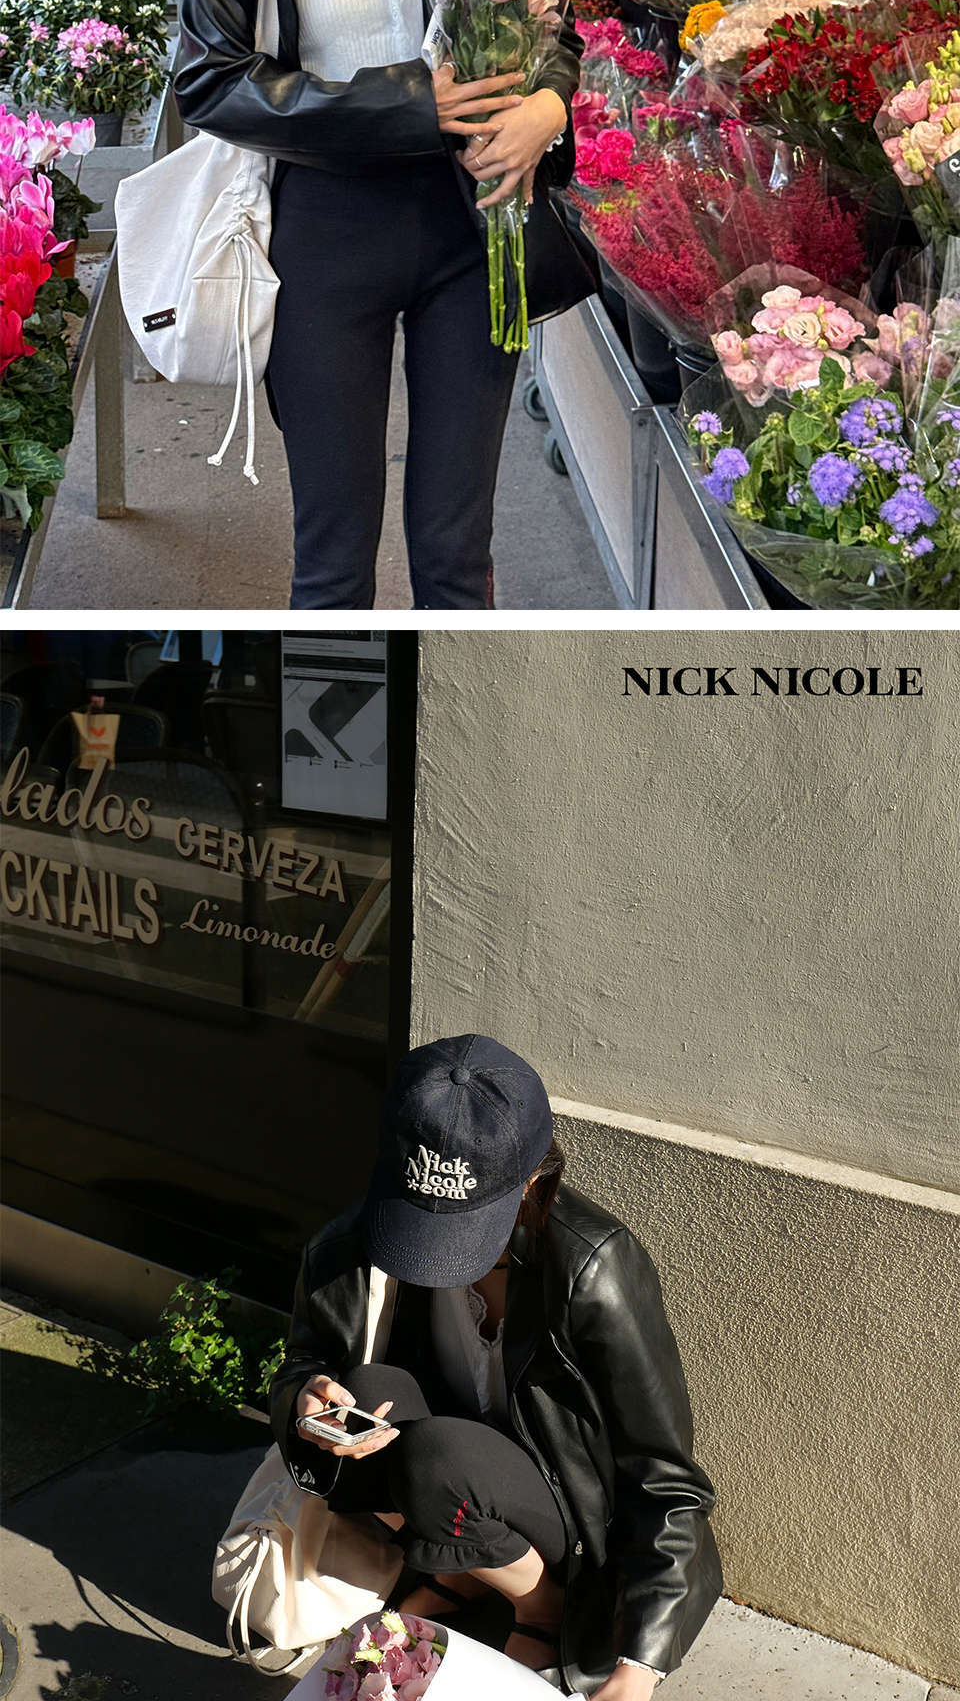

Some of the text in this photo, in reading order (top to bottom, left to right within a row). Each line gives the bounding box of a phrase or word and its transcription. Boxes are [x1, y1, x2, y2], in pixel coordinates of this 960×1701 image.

[173, 816, 347, 904] CERVEZA
[0, 850, 162, 946] CKTAILS
[179, 898, 338, 960] Limonade
[404, 1156, 478, 1190] Nicole
[416, 1144, 471, 1175] Nick
